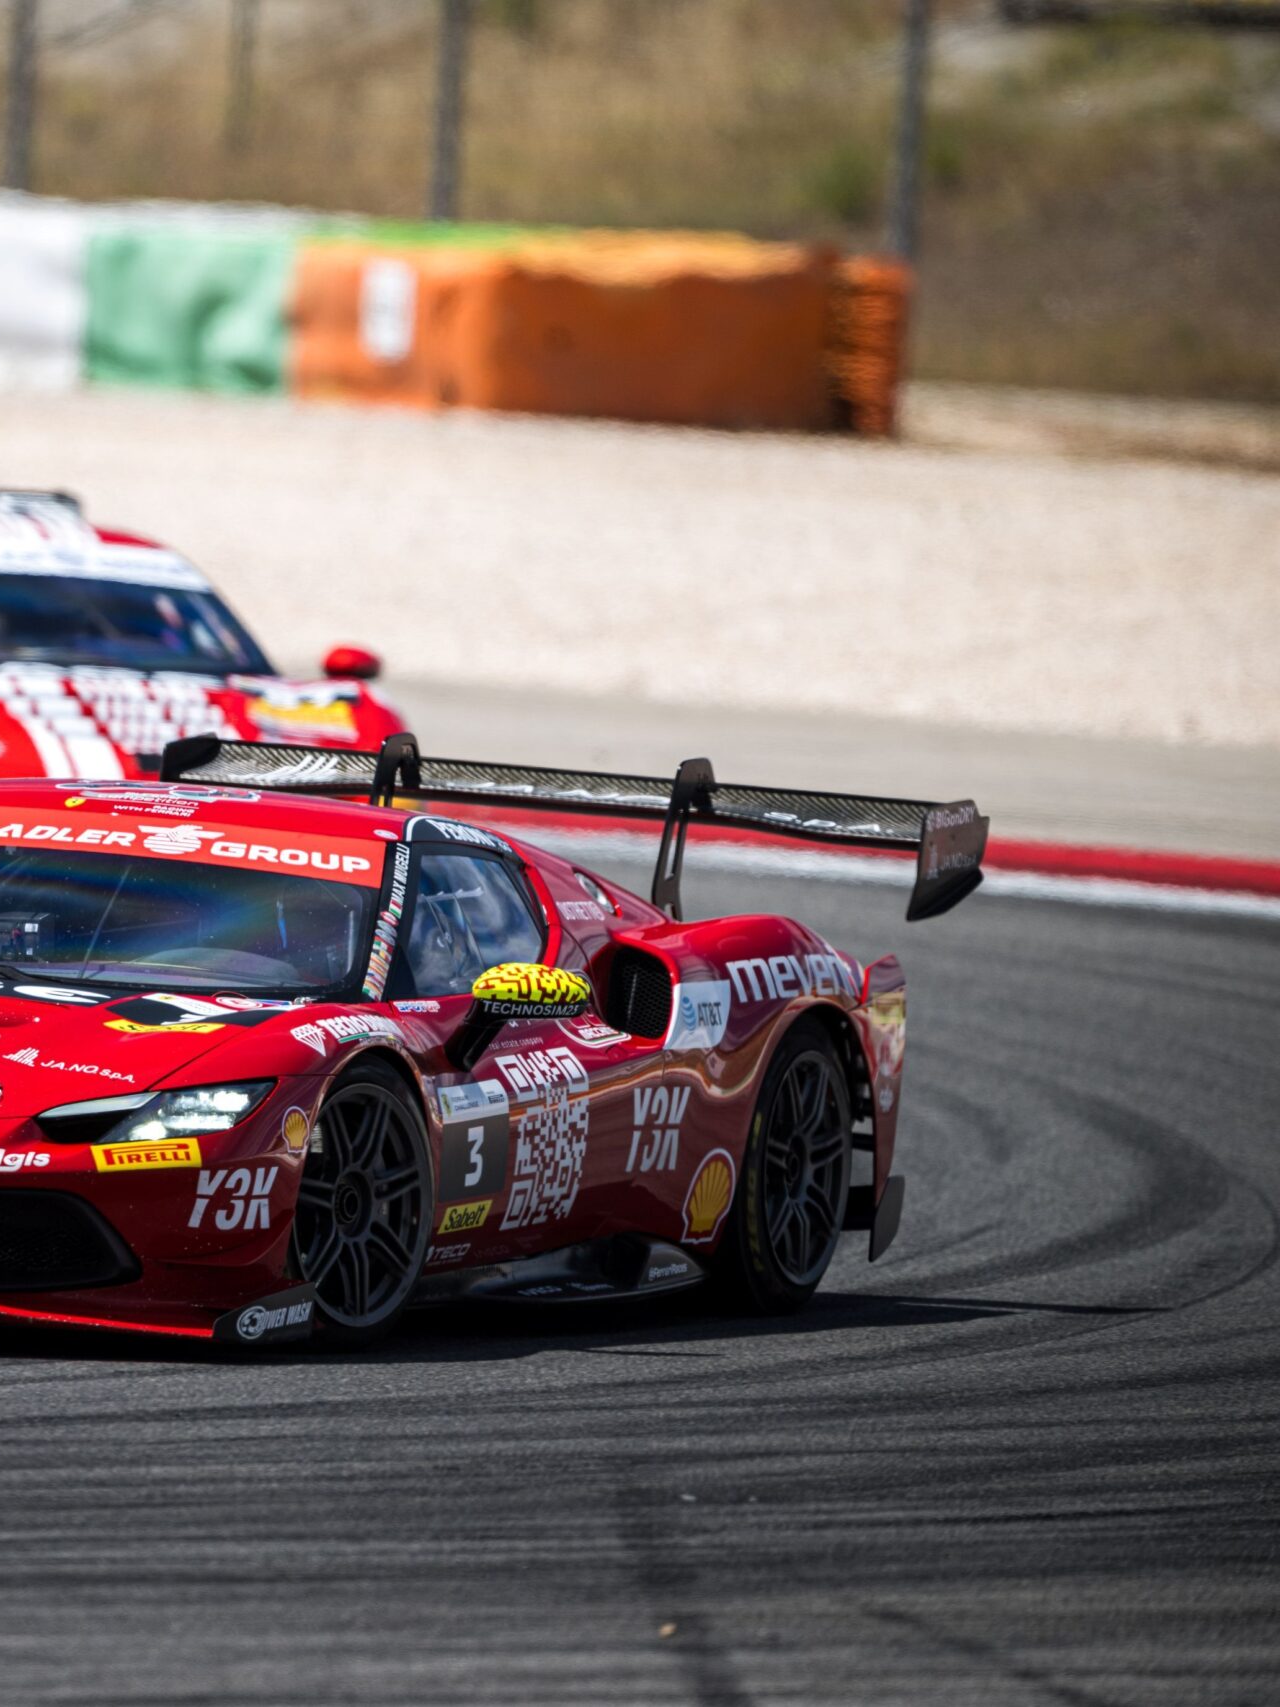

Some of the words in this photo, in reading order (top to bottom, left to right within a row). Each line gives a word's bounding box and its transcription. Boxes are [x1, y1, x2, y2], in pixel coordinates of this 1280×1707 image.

[210, 841, 371, 874] GROUP
[393, 843, 410, 885] MUGELLI
[391, 883, 407, 906] MAX
[482, 1000, 580, 1017] TECHNOSIM25
[696, 1002, 723, 1027] AT&T
[103, 1143, 192, 1165] PIRELLI
[463, 1125, 485, 1188] 3
[187, 1166, 279, 1231] Y3K
[444, 1205, 486, 1231] Sabelt
